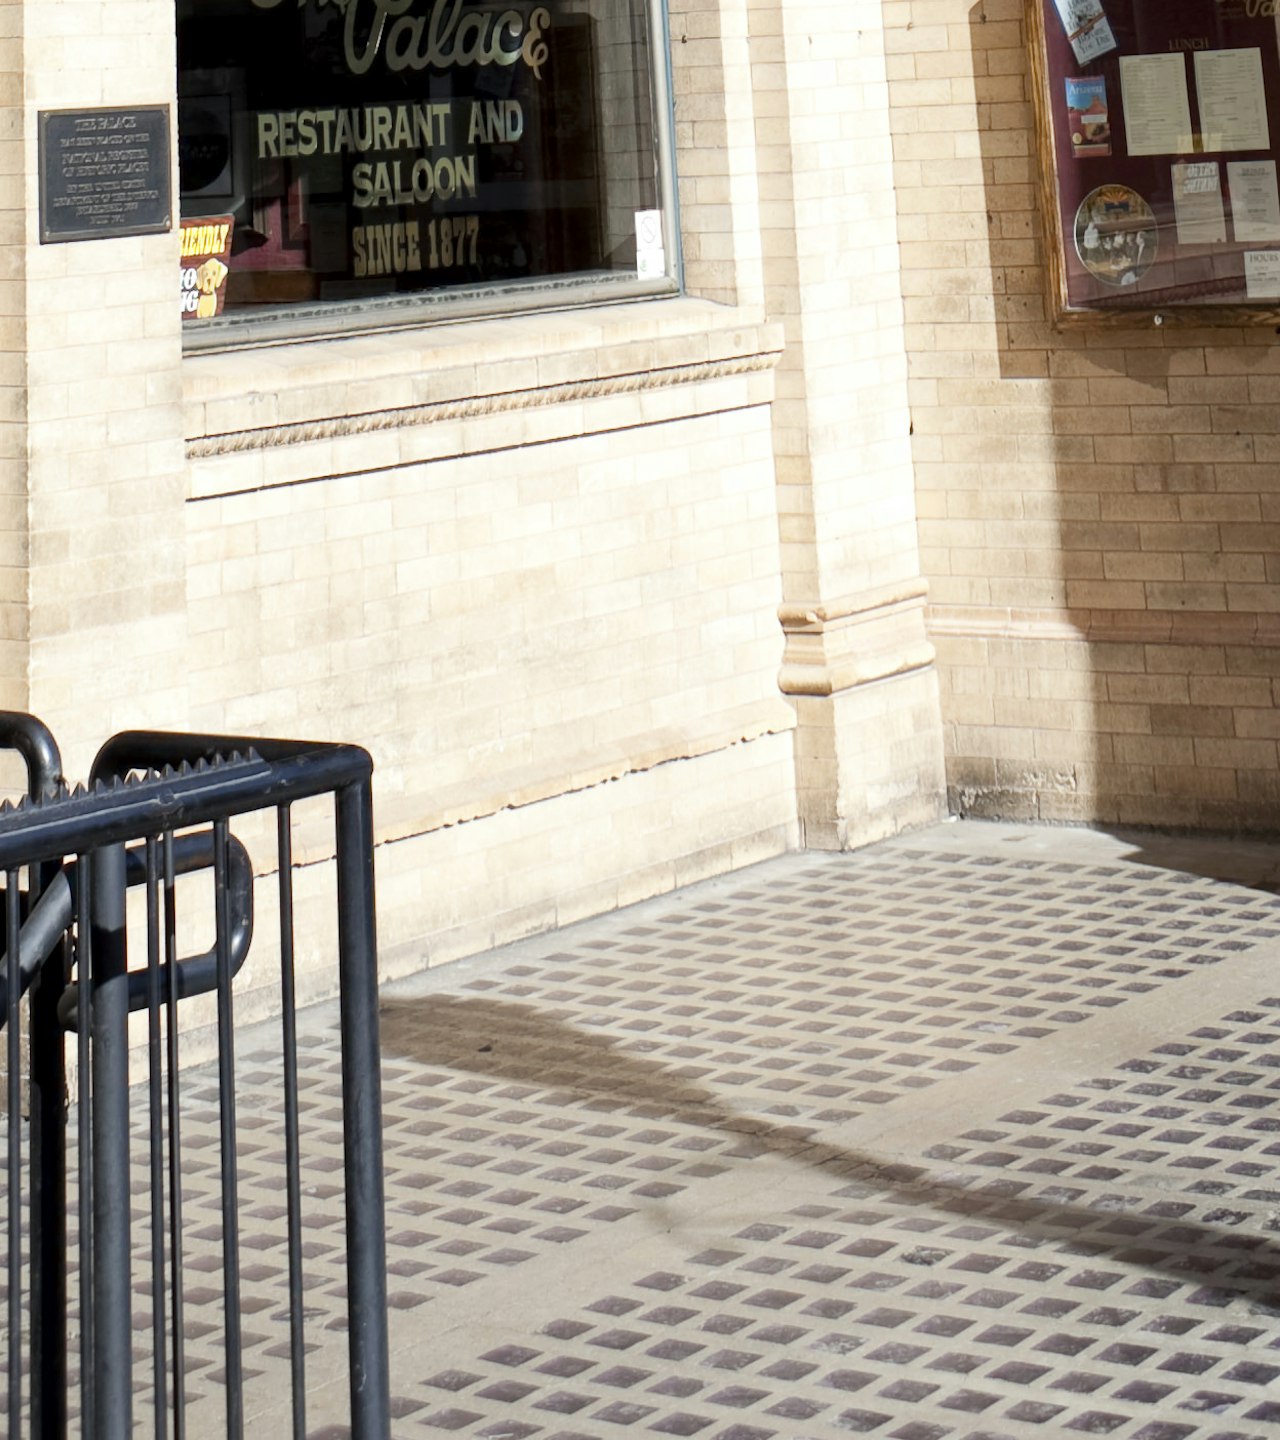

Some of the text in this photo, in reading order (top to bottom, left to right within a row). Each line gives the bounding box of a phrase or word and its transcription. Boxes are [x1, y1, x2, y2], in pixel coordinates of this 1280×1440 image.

[1168, 38, 1210, 52] LUNCH
[257, 100, 524, 159] RESTAURANT AND
[352, 155, 477, 209] SALOON
[353, 217, 480, 278] SINCE 1877
